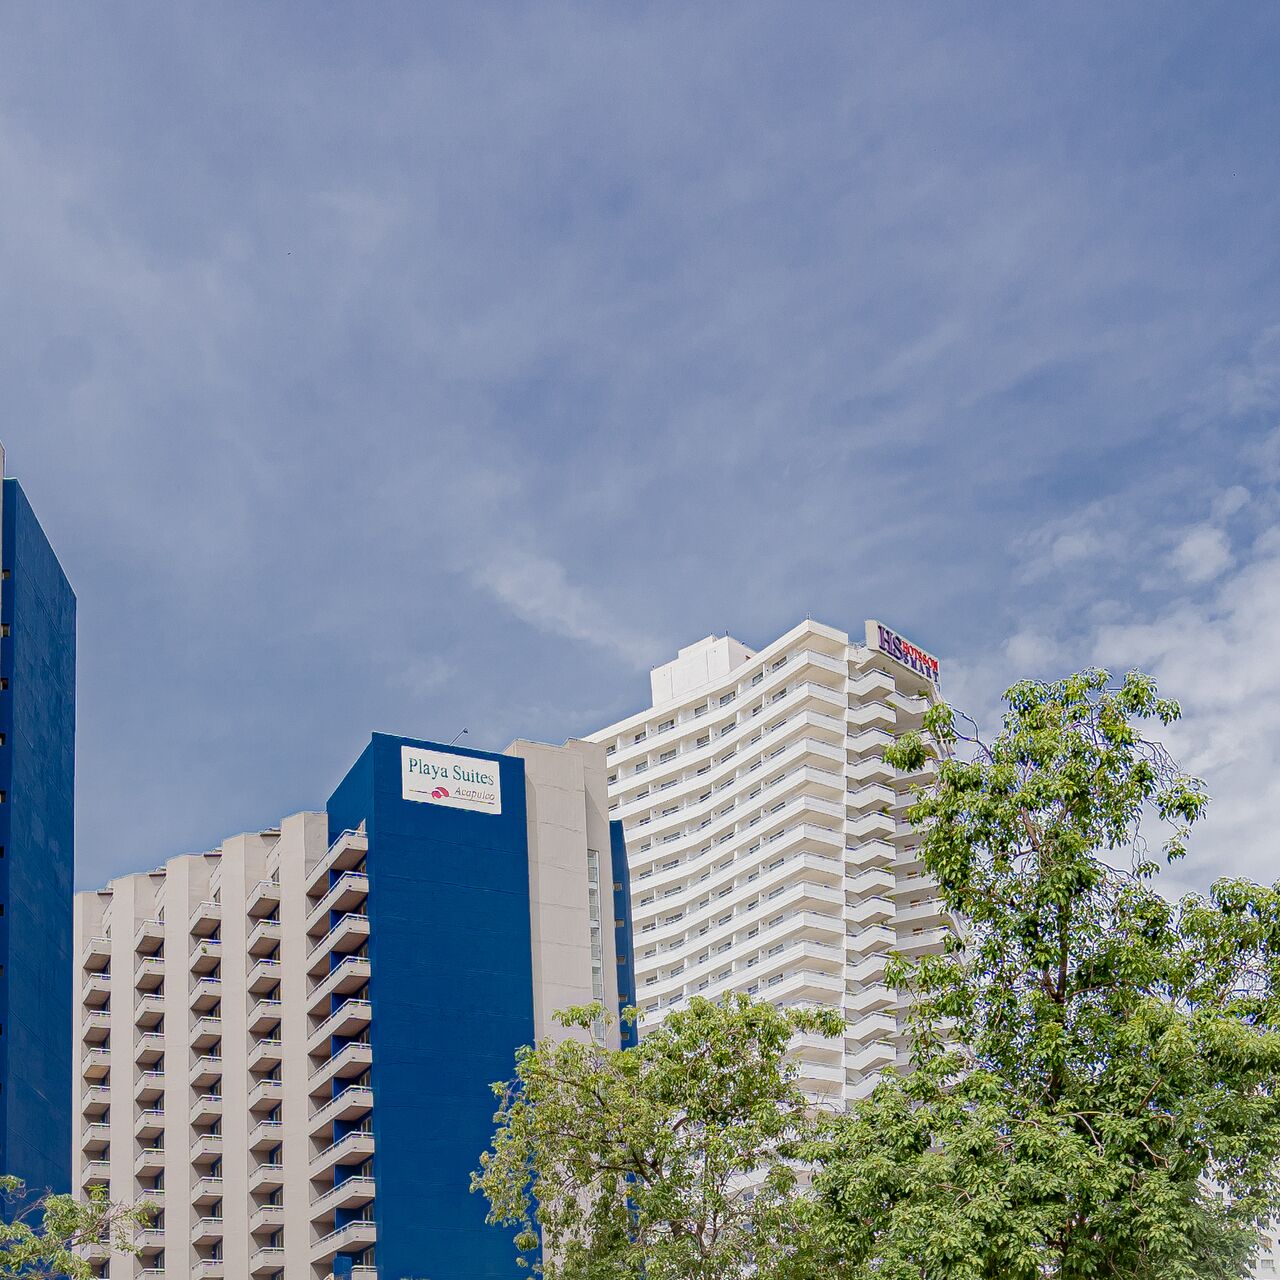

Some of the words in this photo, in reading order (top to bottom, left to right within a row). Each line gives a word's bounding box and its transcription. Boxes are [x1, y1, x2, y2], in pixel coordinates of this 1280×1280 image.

[877, 625, 904, 661] HS
[903, 653, 939, 683] SMART
[408, 757, 449, 780] Playa
[452, 764, 495, 786] Suites
[454, 786, 496, 801] Acapulco
